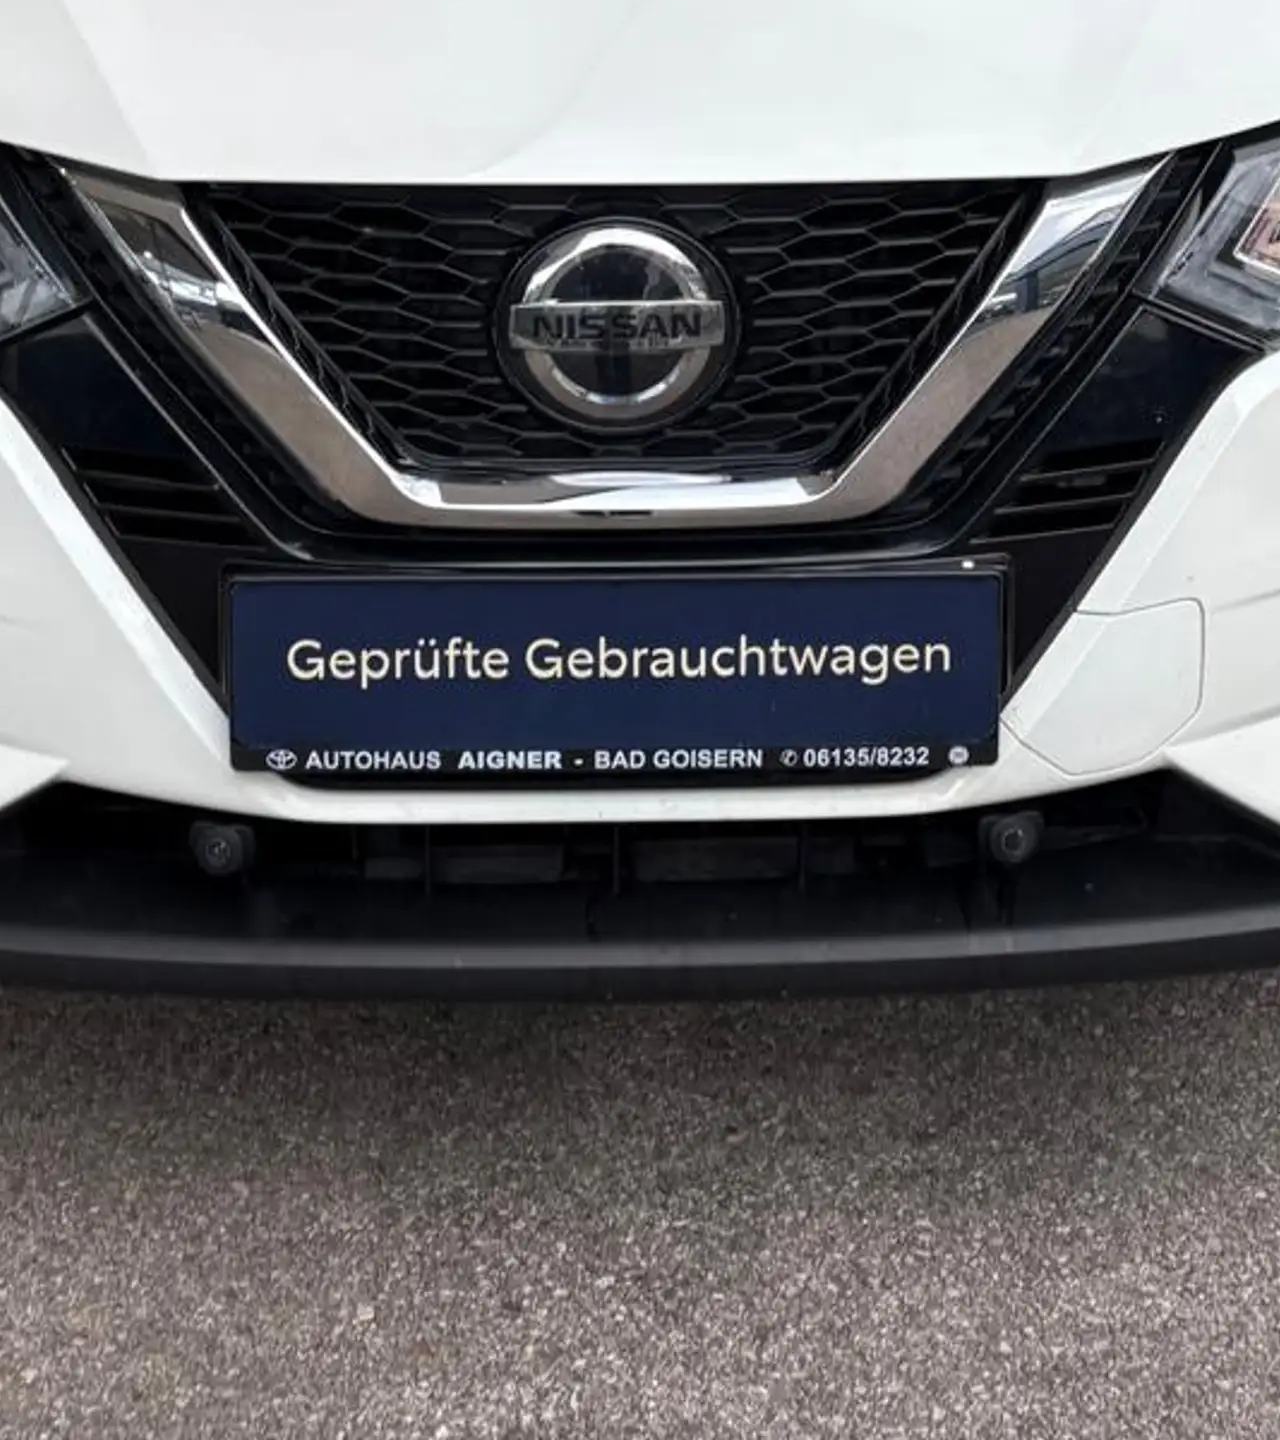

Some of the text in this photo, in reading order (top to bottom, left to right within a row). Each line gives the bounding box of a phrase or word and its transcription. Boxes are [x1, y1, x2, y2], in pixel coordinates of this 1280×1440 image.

[532, 312, 702, 340] NISSAN
[286, 633, 952, 690] Geprüfte Gebrauchtwagen
[305, 746, 930, 770] AUTOHAUS AIGNER BAD GOISERN 06135/8232
